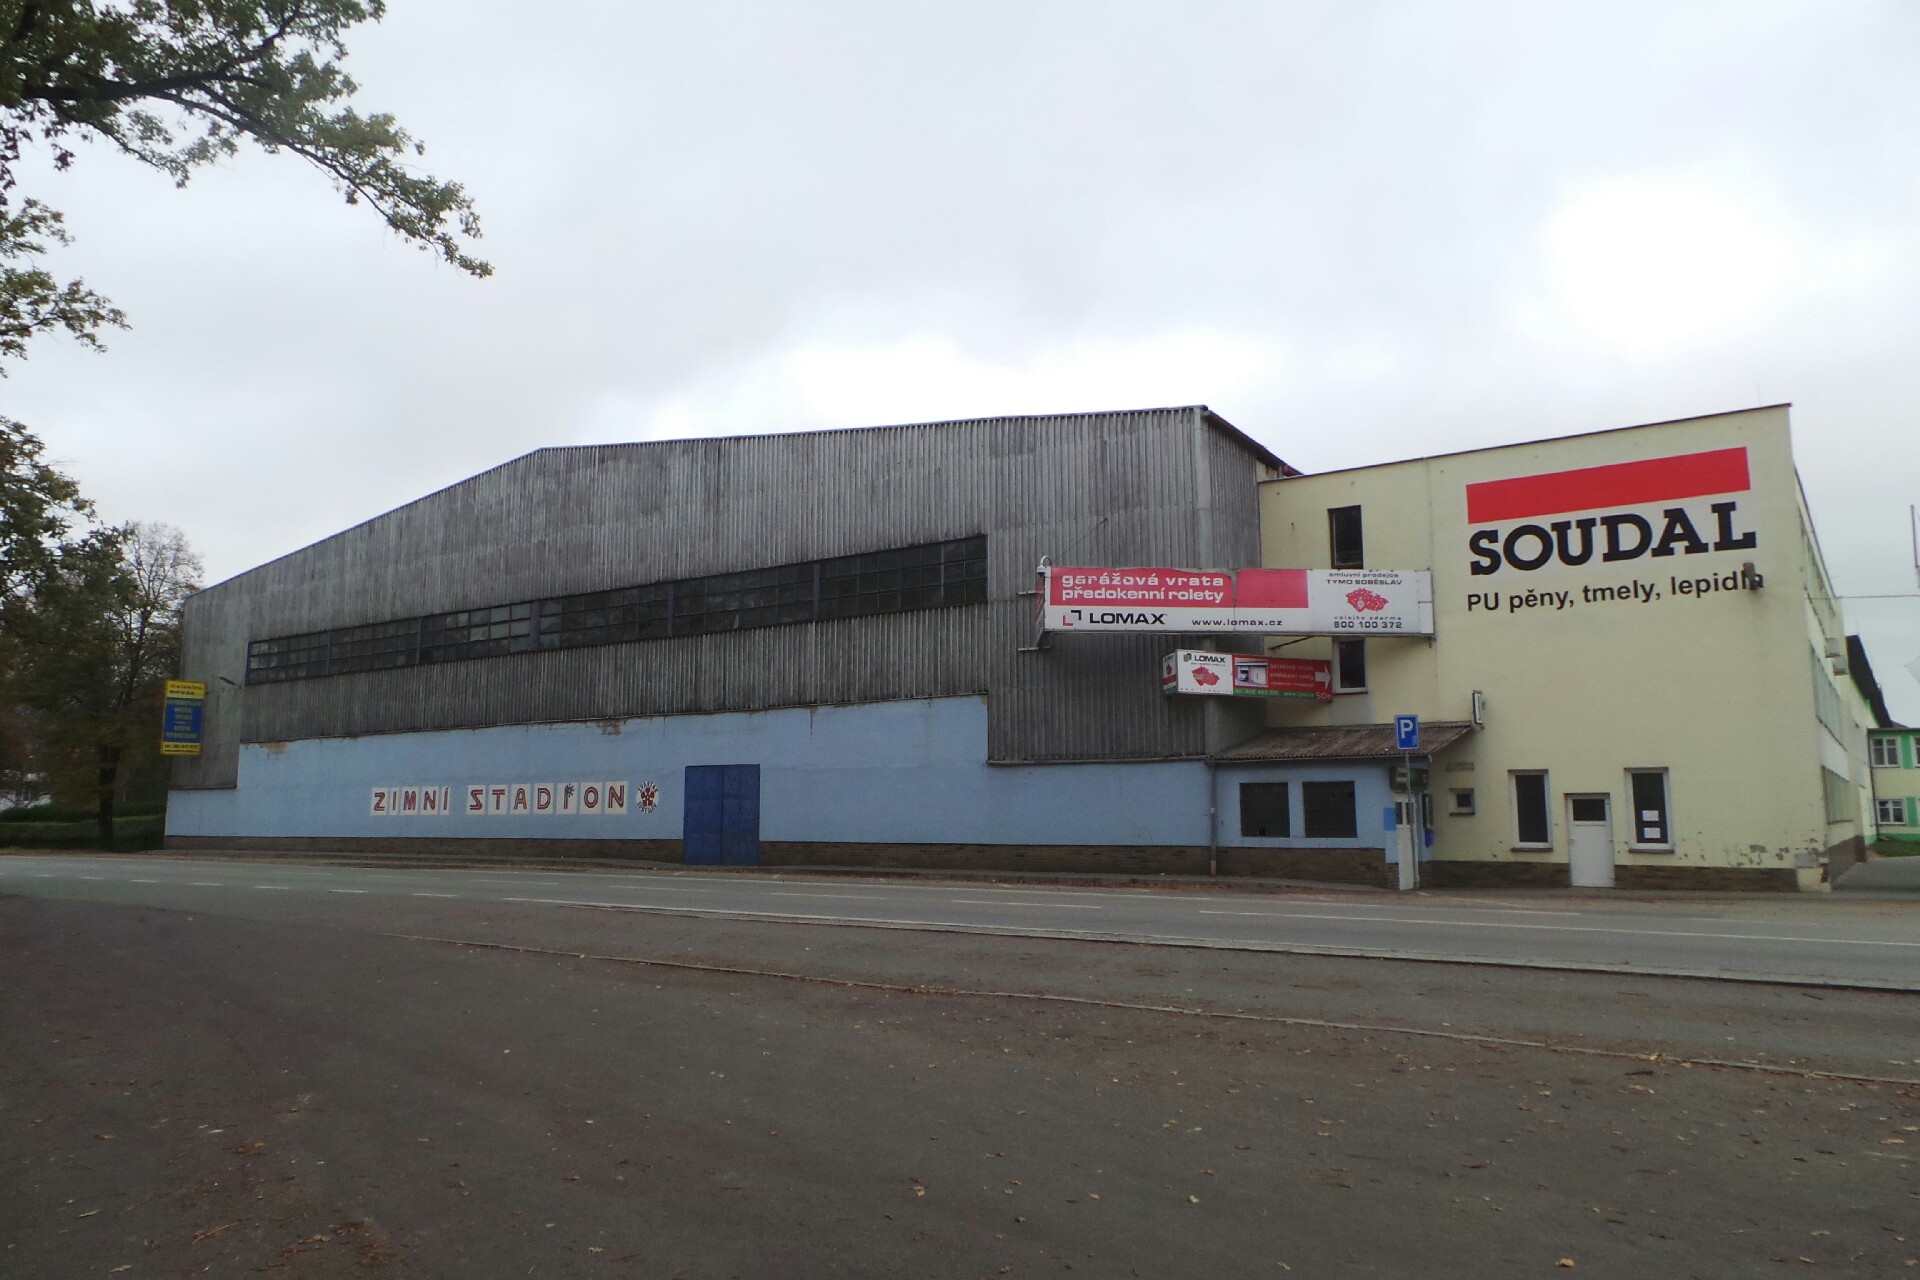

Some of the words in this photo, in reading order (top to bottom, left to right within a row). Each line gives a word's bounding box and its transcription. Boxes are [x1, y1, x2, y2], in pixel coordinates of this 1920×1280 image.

[1468, 501, 1757, 575] SOUDAL
[1061, 573, 1159, 587] garážová
[1165, 576, 1224, 586] vrata
[1062, 587, 1165, 601] předokenní
[1168, 589, 1224, 603] rolety
[1467, 592, 1500, 612] PU
[1509, 588, 1574, 613] pěny,
[1583, 579, 1661, 604] tmely,
[1089, 612, 1166, 625] LOMAX
[1191, 618, 1283, 626] www.lomax.cz
[1333, 621, 1355, 629] 800
[1358, 621, 1378, 629] 100
[1381, 621, 1403, 629] 372
[1194, 654, 1226, 663] LOMAX
[1399, 719, 1414, 739] P
[373, 786, 450, 812] ZIMNÍ
[469, 784, 625, 810] STADION
